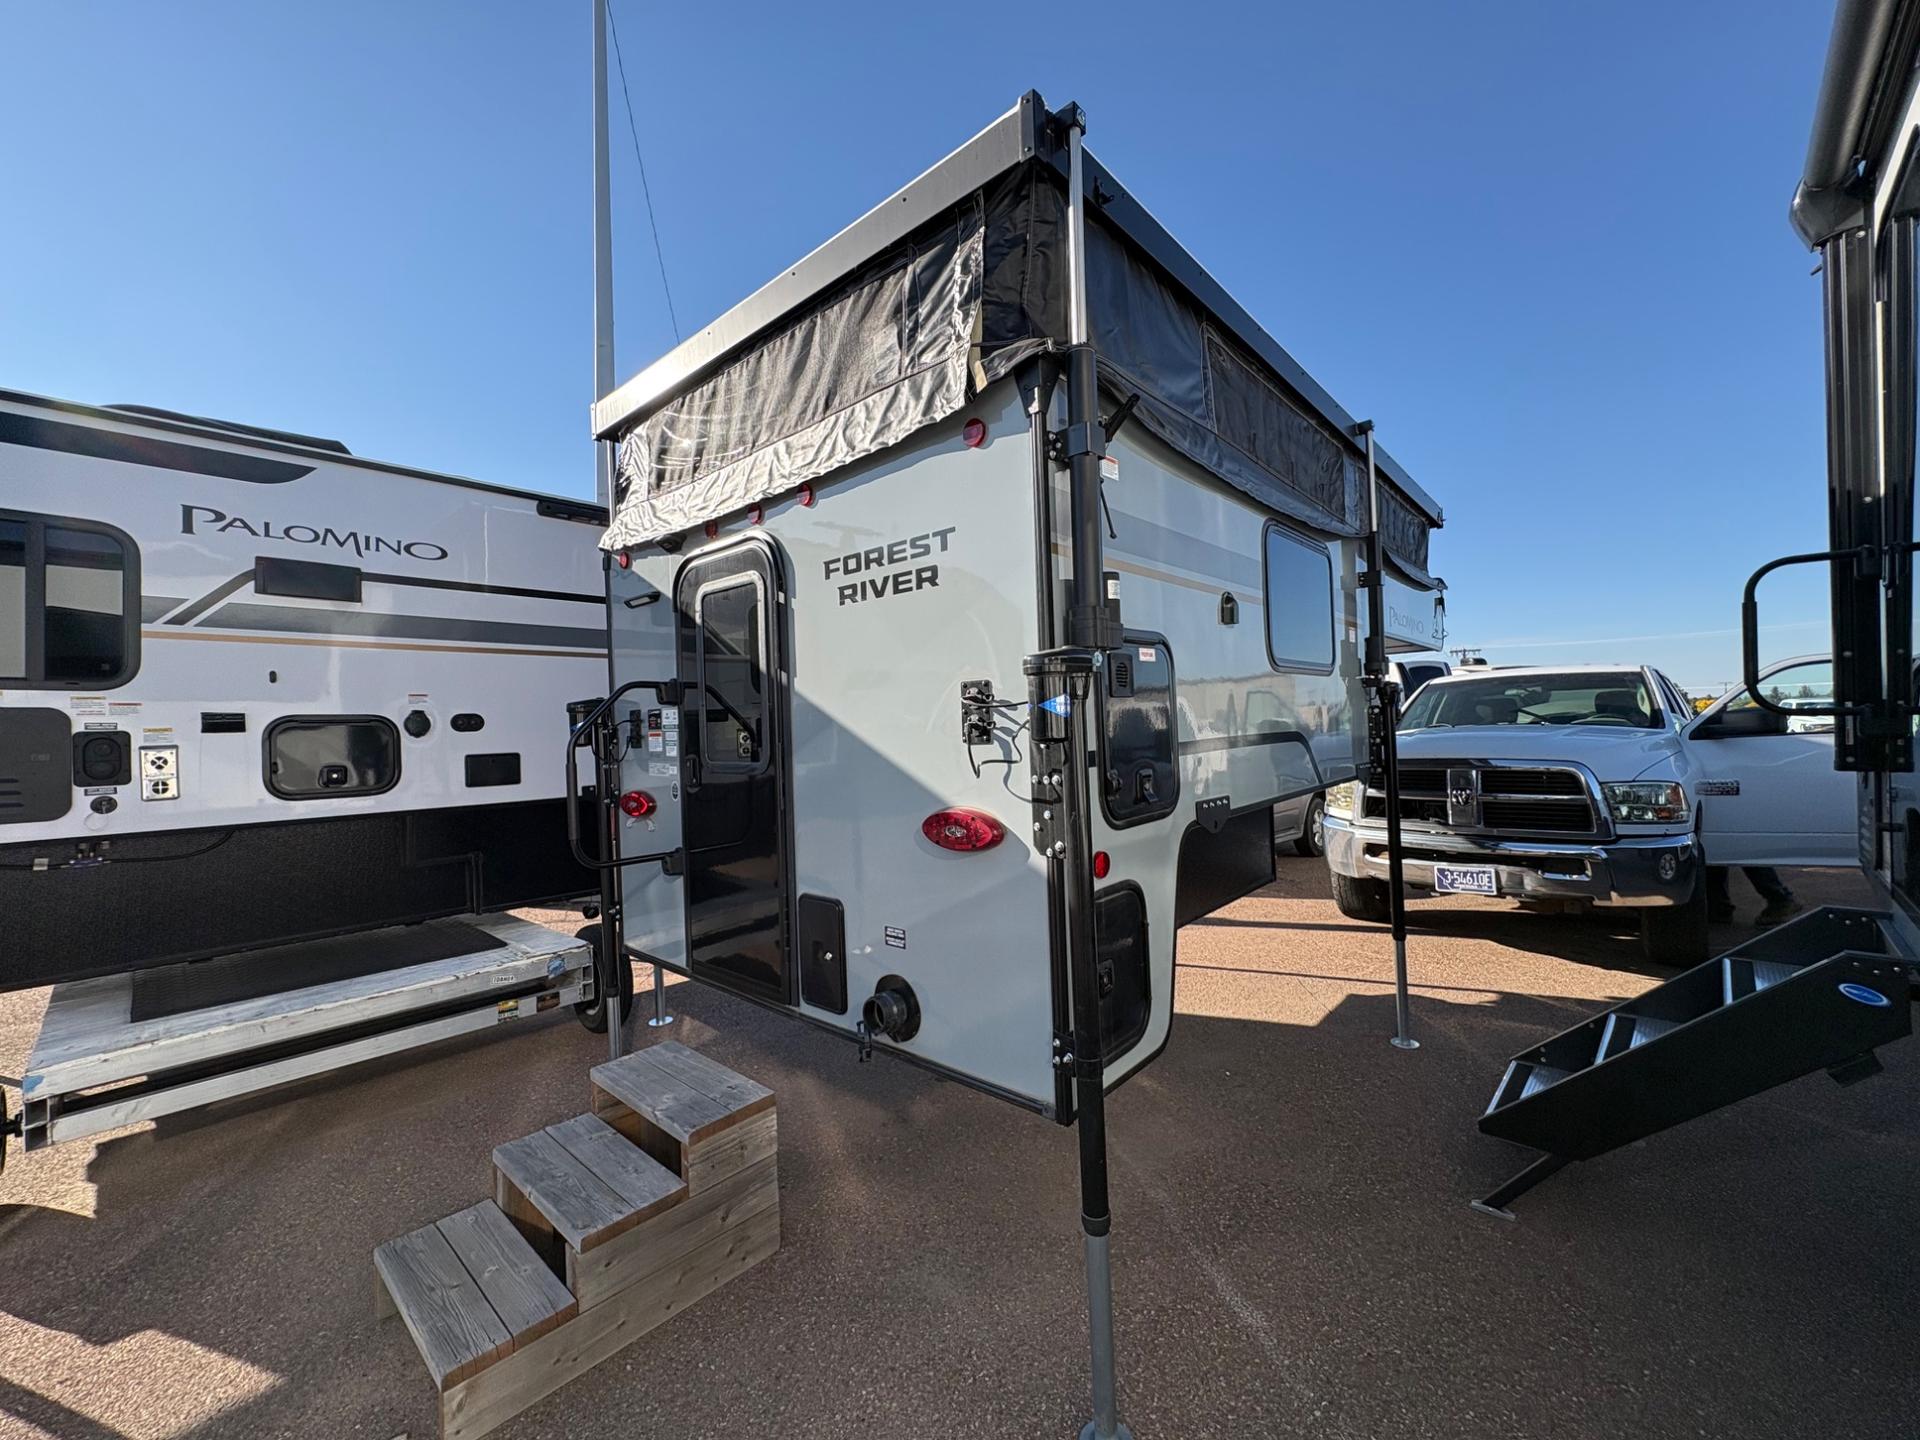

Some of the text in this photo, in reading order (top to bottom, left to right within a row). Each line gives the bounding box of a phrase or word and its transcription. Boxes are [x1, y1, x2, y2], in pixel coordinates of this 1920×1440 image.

[180, 504, 449, 561] PALOMINO
[823, 526, 956, 581] FOREST
[837, 564, 939, 606] RIVER
